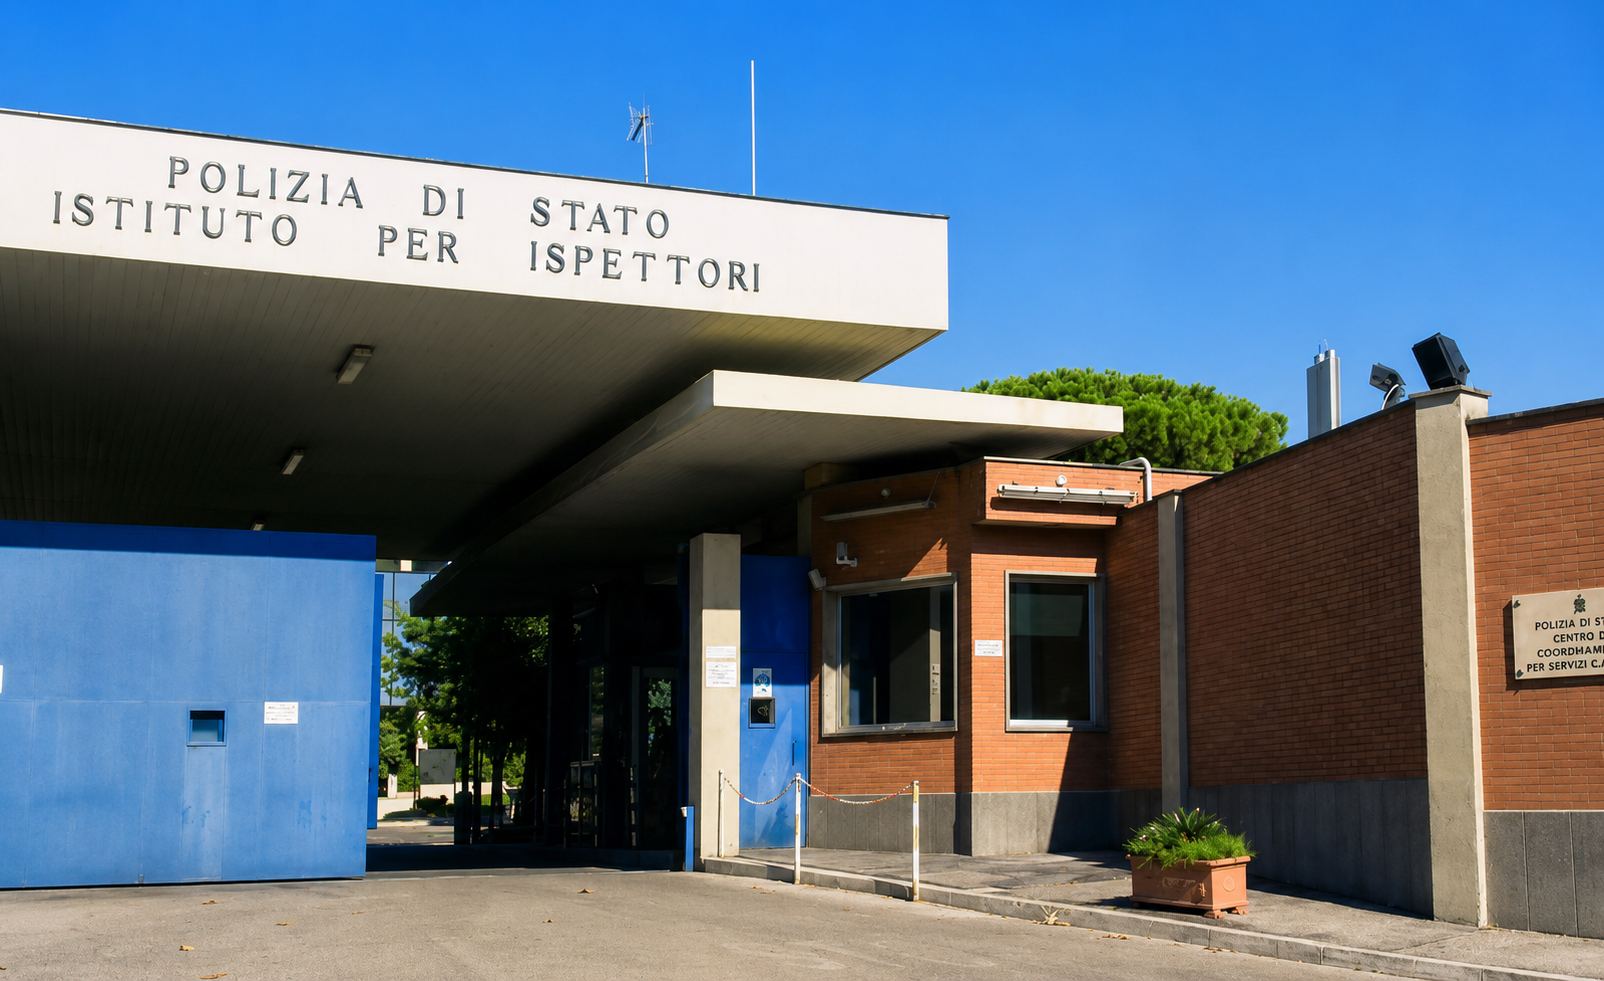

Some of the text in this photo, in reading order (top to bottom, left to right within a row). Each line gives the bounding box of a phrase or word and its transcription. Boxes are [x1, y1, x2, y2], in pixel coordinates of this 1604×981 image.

[167, 156, 670, 239] POLIZIA DI STATO
[52, 190, 761, 293] ISTITUTO PER ISPETTORI
[1535, 619, 1576, 631] POLIZIA
[1579, 617, 1591, 628] DI
[1553, 631, 1595, 644] CENTRO
[1526, 662, 1545, 673] PER
[1548, 659, 1588, 671] SERVIZI
